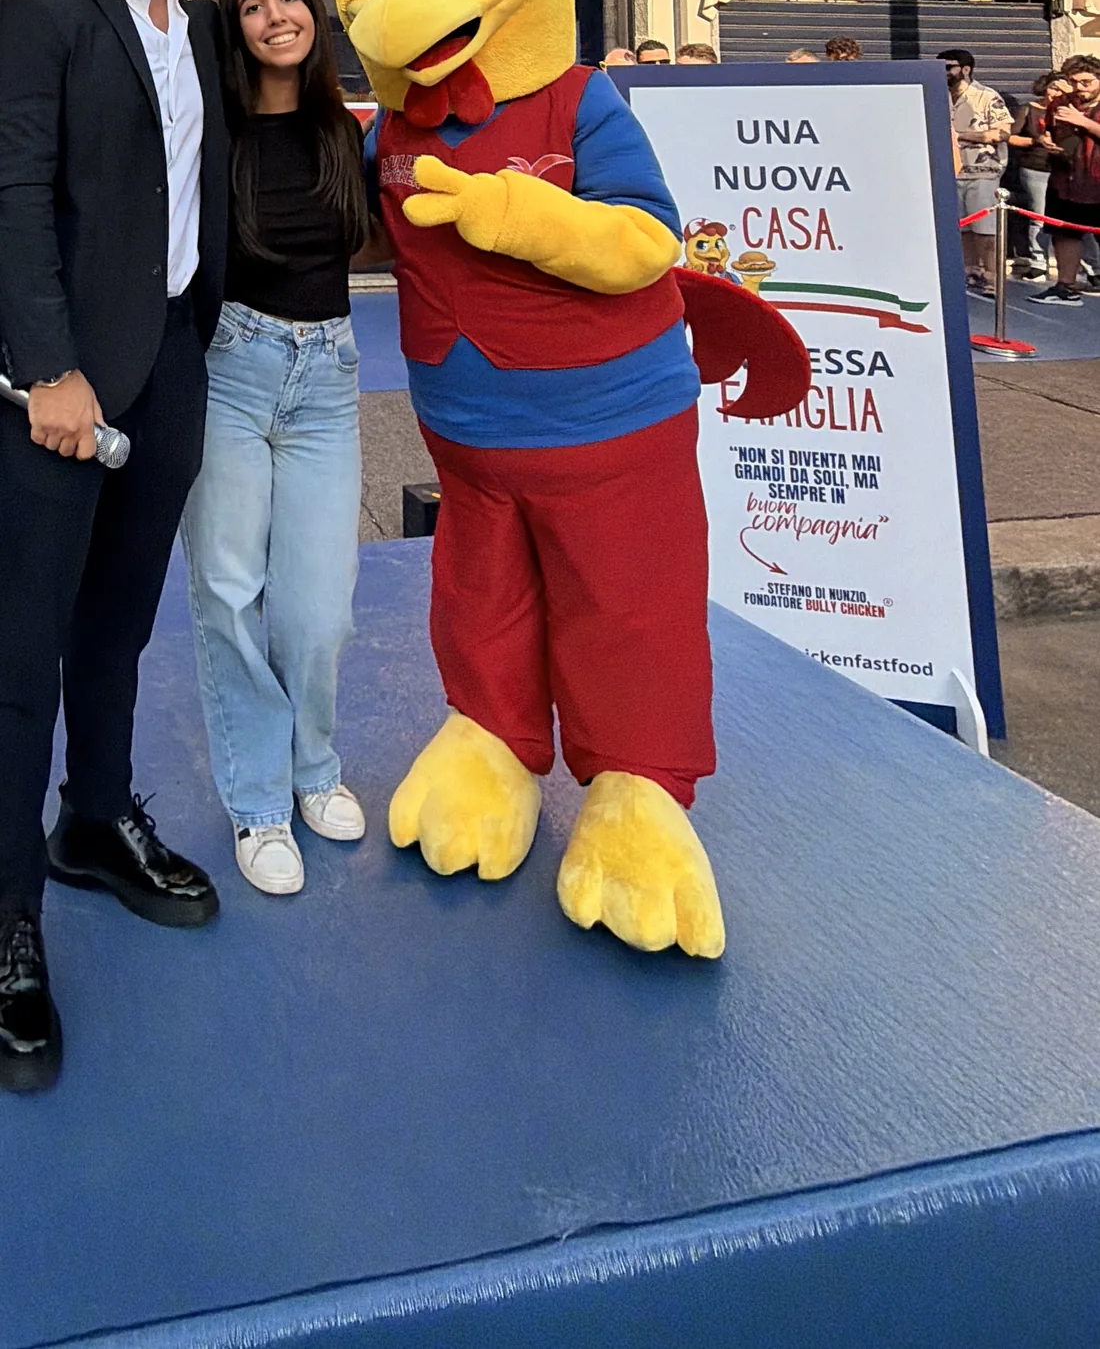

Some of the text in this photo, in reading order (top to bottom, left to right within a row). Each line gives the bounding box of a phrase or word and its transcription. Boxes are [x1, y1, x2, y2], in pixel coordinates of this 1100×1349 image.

[736, 119, 819, 145] UNA
[713, 165, 851, 192] NUOVA
[742, 206, 844, 251] CASA.
[805, 347, 894, 377] ESSA
[771, 448, 784, 465] SI
[789, 450, 848, 470] DIVENTA
[852, 454, 881, 472] MAI
[734, 463, 879, 489] GRANDI DA SOLI, MA
[746, 492, 798, 514] buona
[768, 482, 846, 504] SEMPRE IN
[743, 592, 886, 618] FONDATORE BULLY CHICKEN
[767, 582, 812, 598] STEFANO
[815, 586, 826, 599] DI
[829, 588, 871, 606] NUNZIO,
[805, 648, 934, 677] kenfastfood
